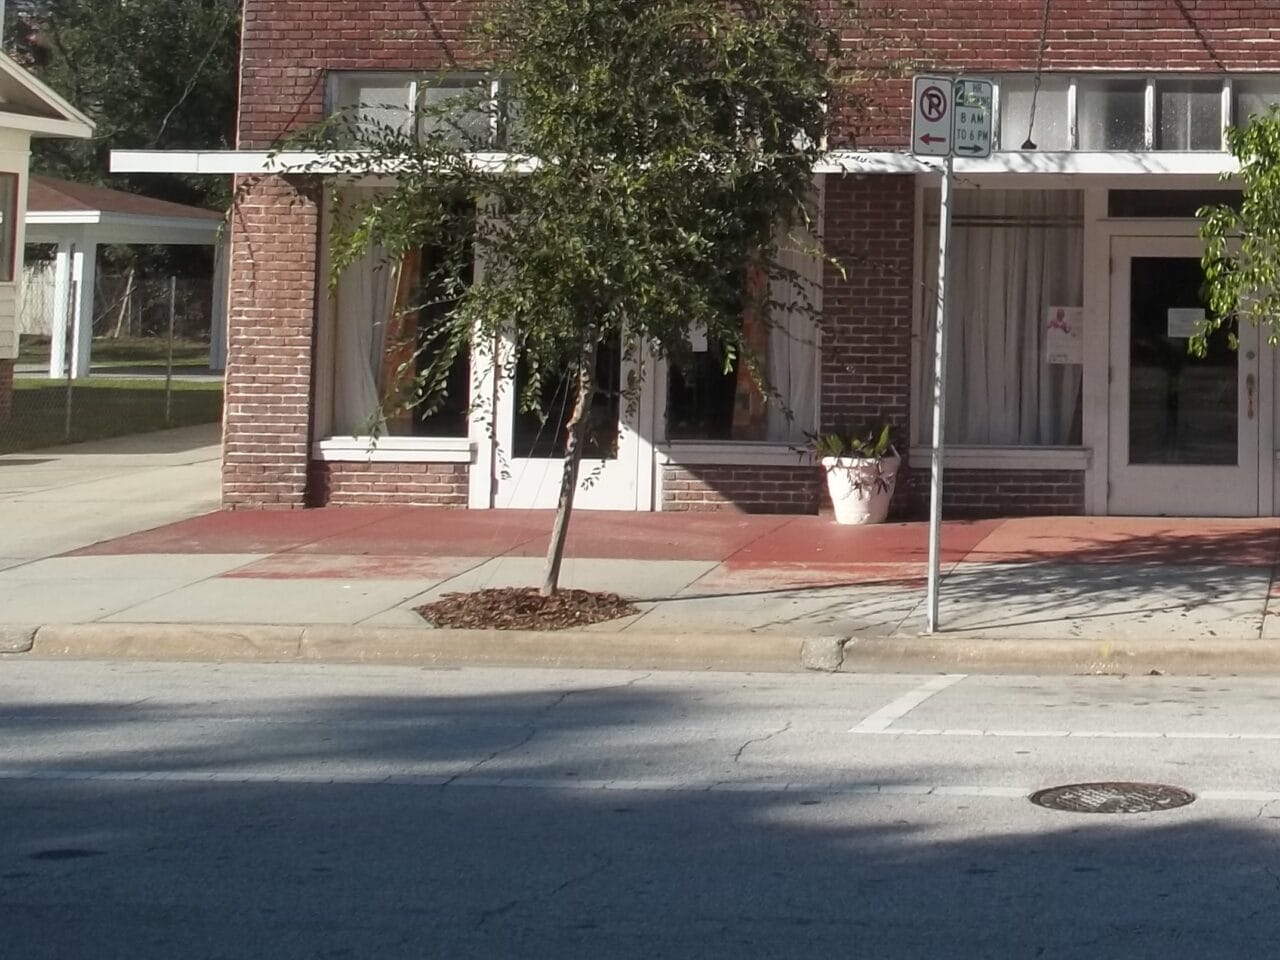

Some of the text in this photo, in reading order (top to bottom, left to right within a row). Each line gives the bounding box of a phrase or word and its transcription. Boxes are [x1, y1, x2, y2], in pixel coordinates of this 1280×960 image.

[955, 83, 964, 102] 2
[927, 93, 942, 115] P
[960, 112, 984, 124] 8 AM
[957, 128, 988, 141] TO 6 PM
